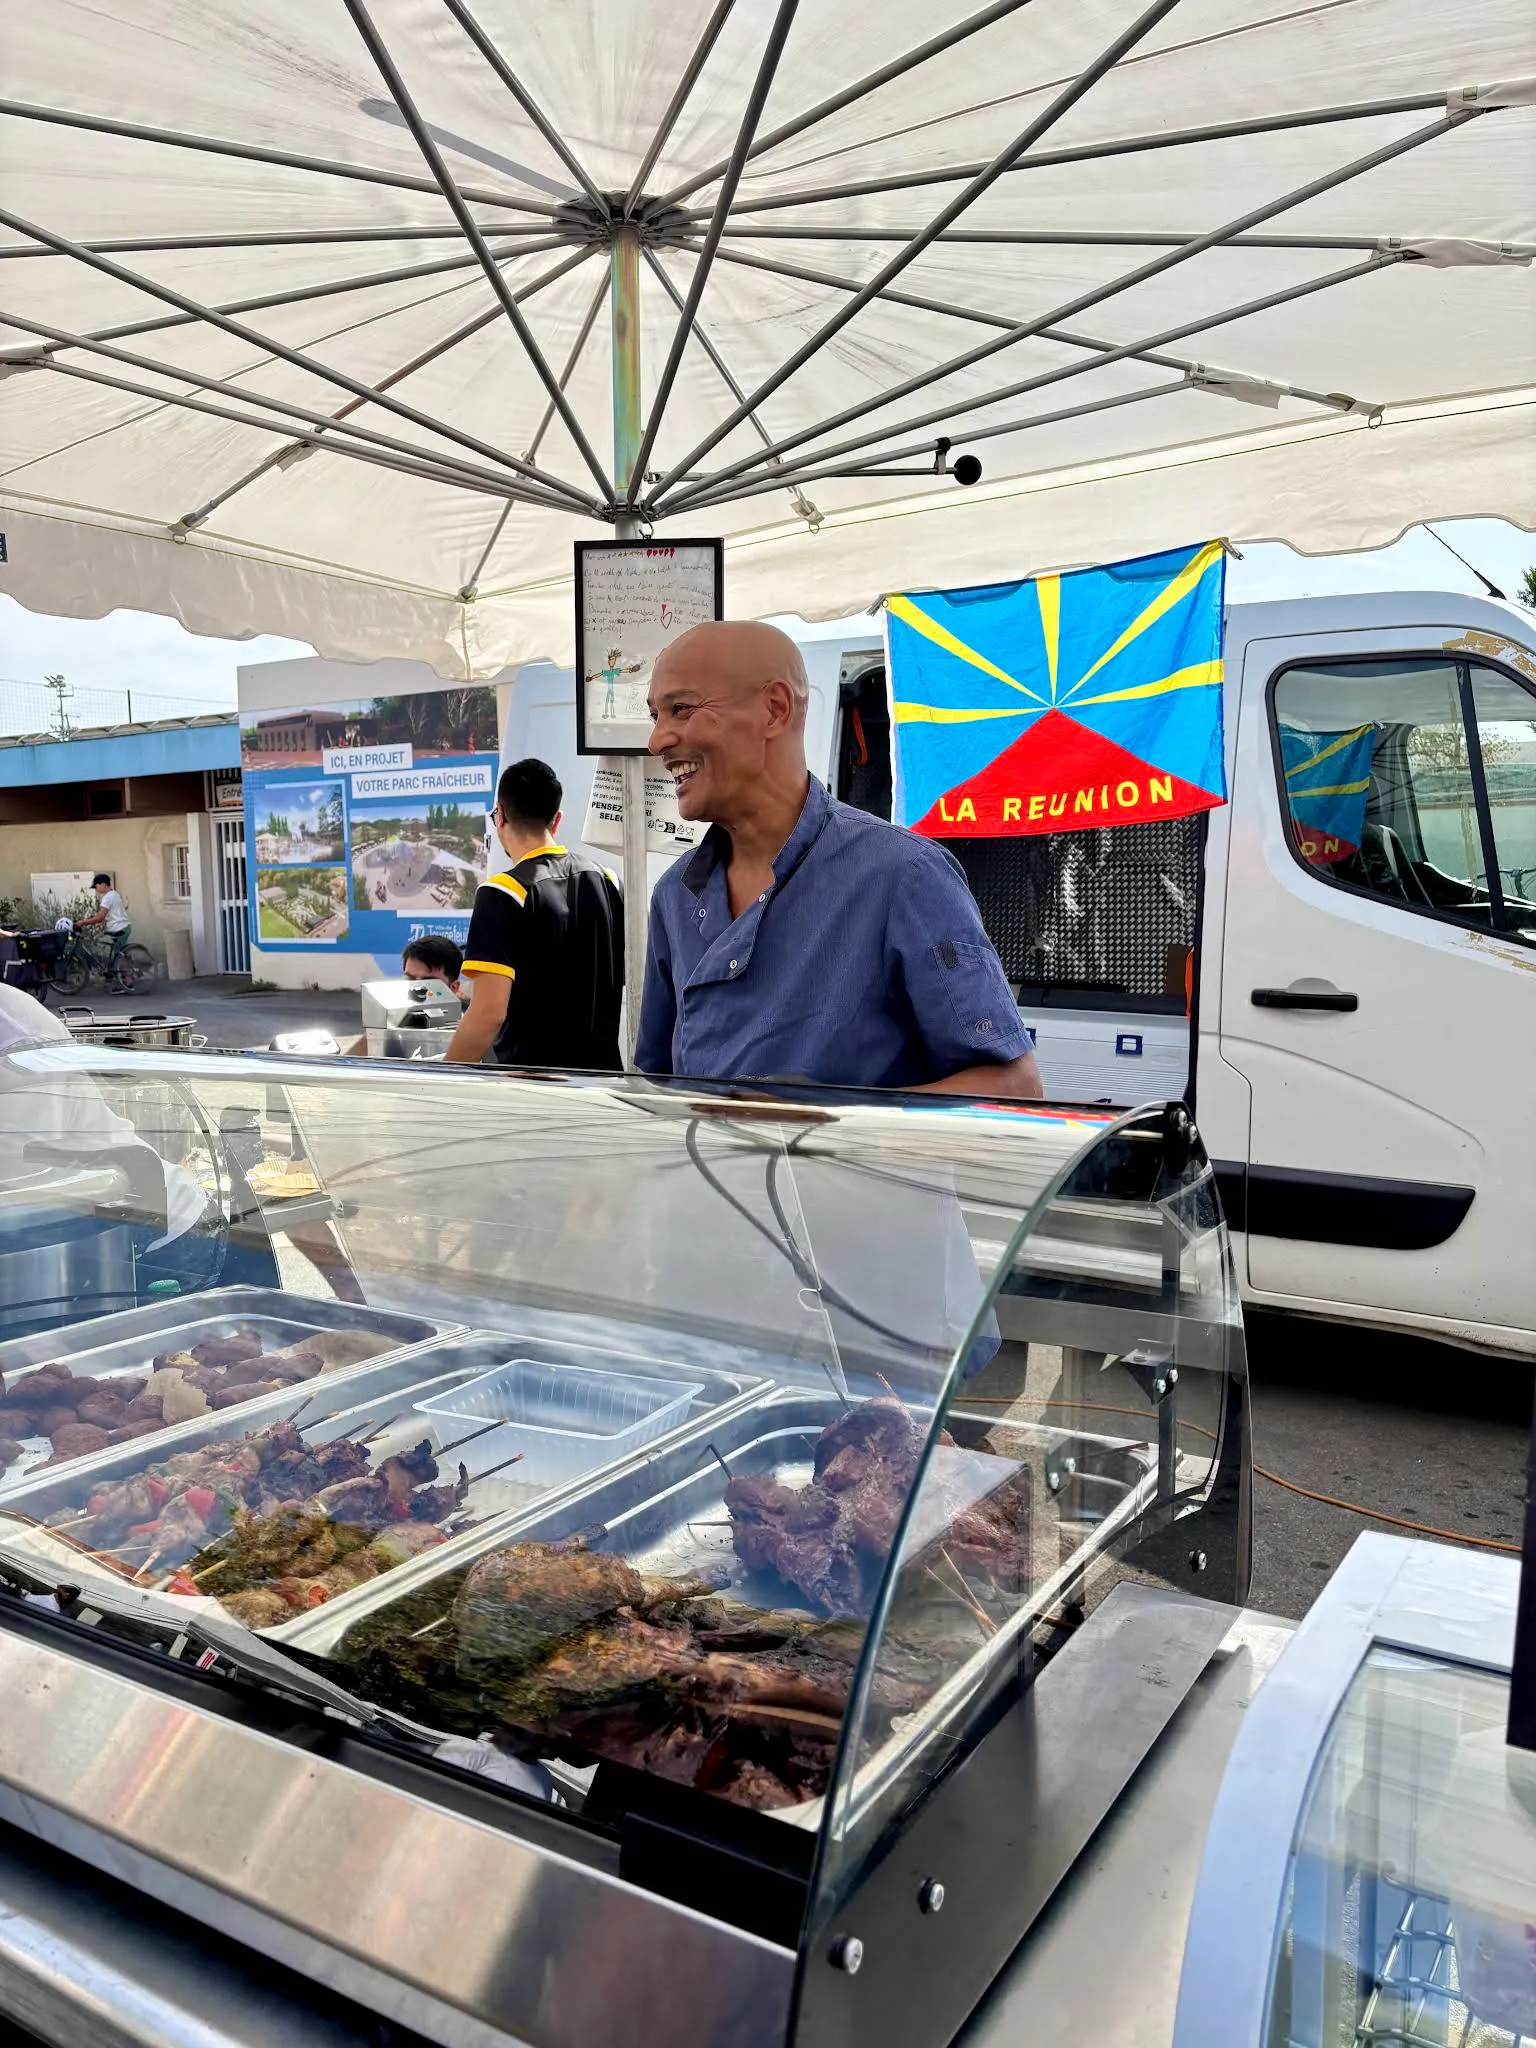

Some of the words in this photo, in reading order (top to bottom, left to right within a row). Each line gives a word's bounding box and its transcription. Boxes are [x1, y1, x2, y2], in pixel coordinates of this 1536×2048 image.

[331, 756, 347, 769] ICI,
[349, 755, 362, 766] EN
[365, 751, 405, 765] PROJET
[356, 779, 390, 792] VOTRE
[392, 777, 419, 790] PARC
[592, 802, 622, 813] PENSEZ
[939, 797, 977, 822] LA
[1003, 776, 1174, 822] REUNION
[1300, 838, 1339, 857] ON
